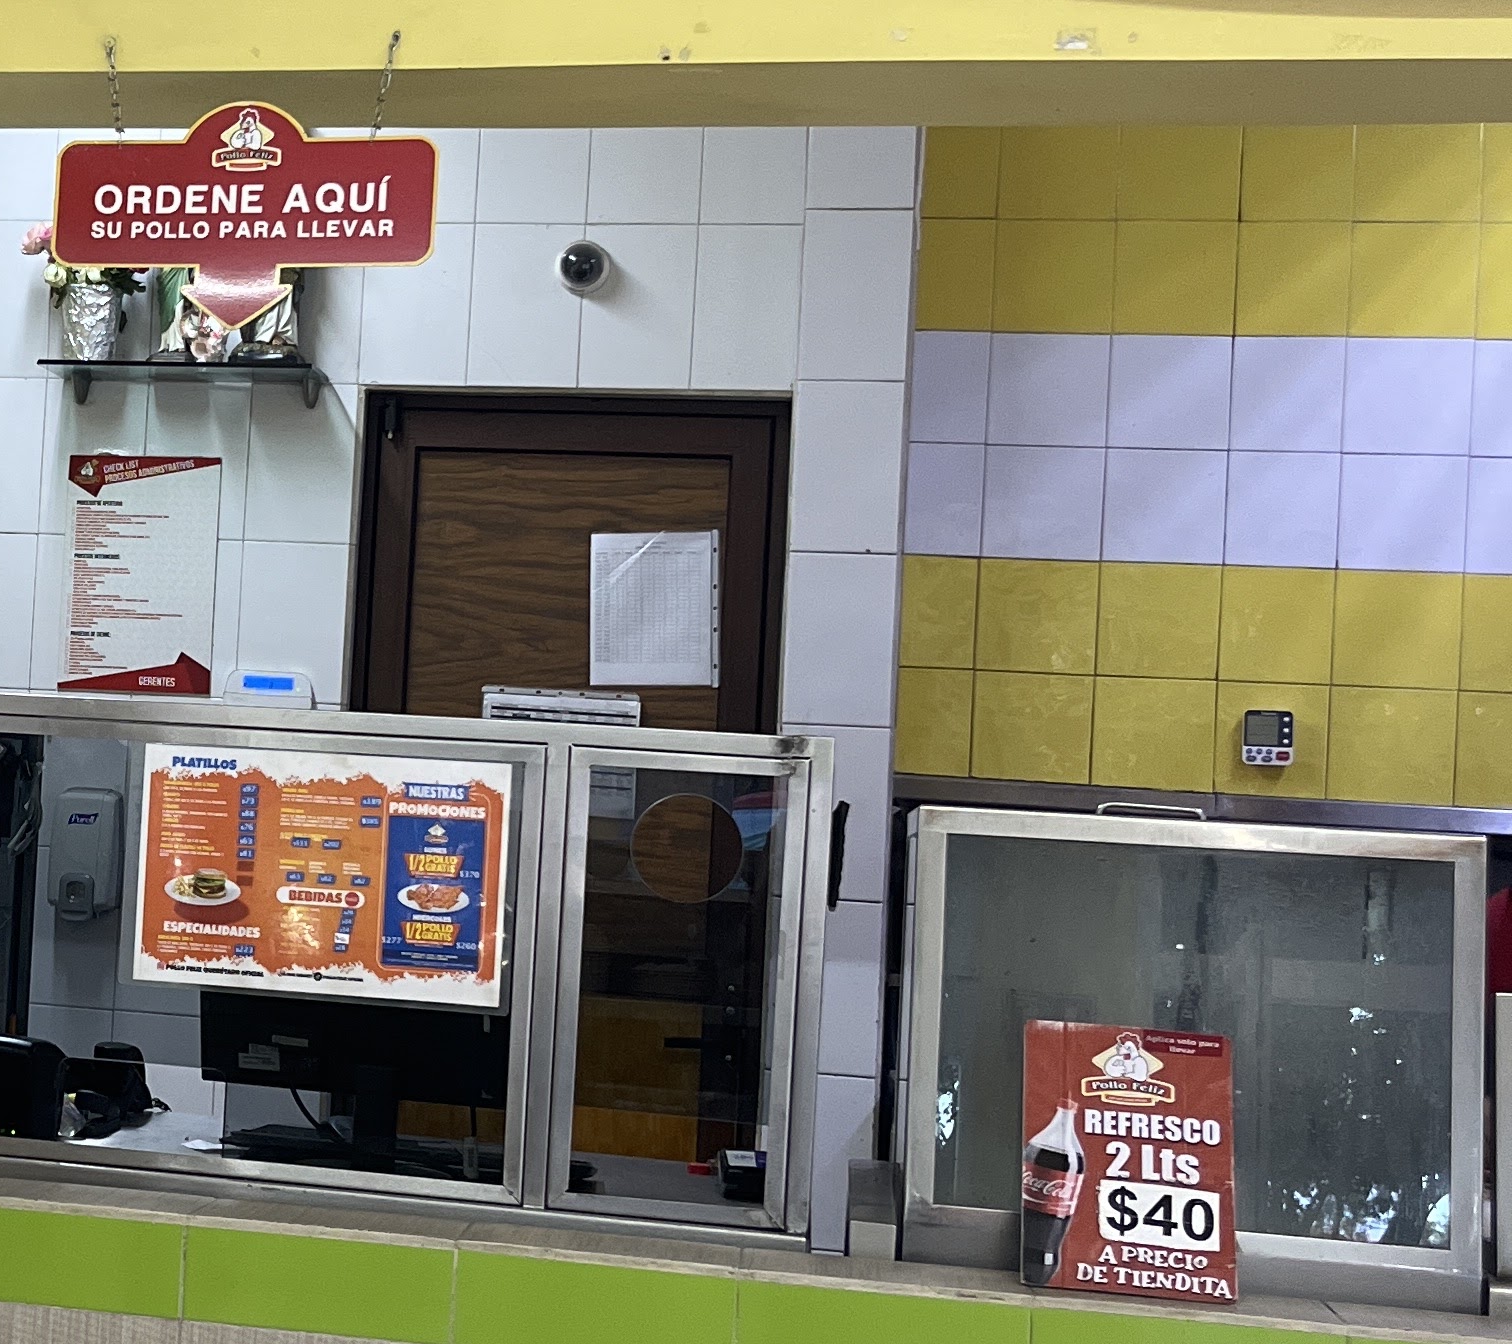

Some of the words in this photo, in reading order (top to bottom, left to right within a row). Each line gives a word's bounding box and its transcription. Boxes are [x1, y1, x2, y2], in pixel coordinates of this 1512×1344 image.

[93, 184, 265, 216] ORDENE
[282, 174, 392, 214] AQUÍ
[90, 220, 123, 240] SU
[130, 220, 210, 239] POLLO
[219, 219, 287, 239] PARA
[296, 218, 395, 239] LLEVAR
[172, 756, 238, 771] PLATILLOS
[408, 785, 465, 800] NUESTRAS
[388, 801, 486, 818] PROMOCIONES
[288, 890, 343, 904] BEBIDAS
[163, 920, 261, 939] ESPECIALIDADES
[1091, 1080, 1128, 1091] Pollo
[1132, 1081, 1166, 1096] Feliz
[1083, 1108, 1221, 1146] REFRESCO
[1105, 1141, 1131, 1178] 2
[1140, 1143, 1201, 1186] Lts
[1106, 1185, 1215, 1241] $40
[1097, 1244, 1118, 1264] A
[1120, 1246, 1208, 1270] PRECIO
[1076, 1262, 1109, 1284] DE
[1111, 1266, 1233, 1299] TIENDITA
